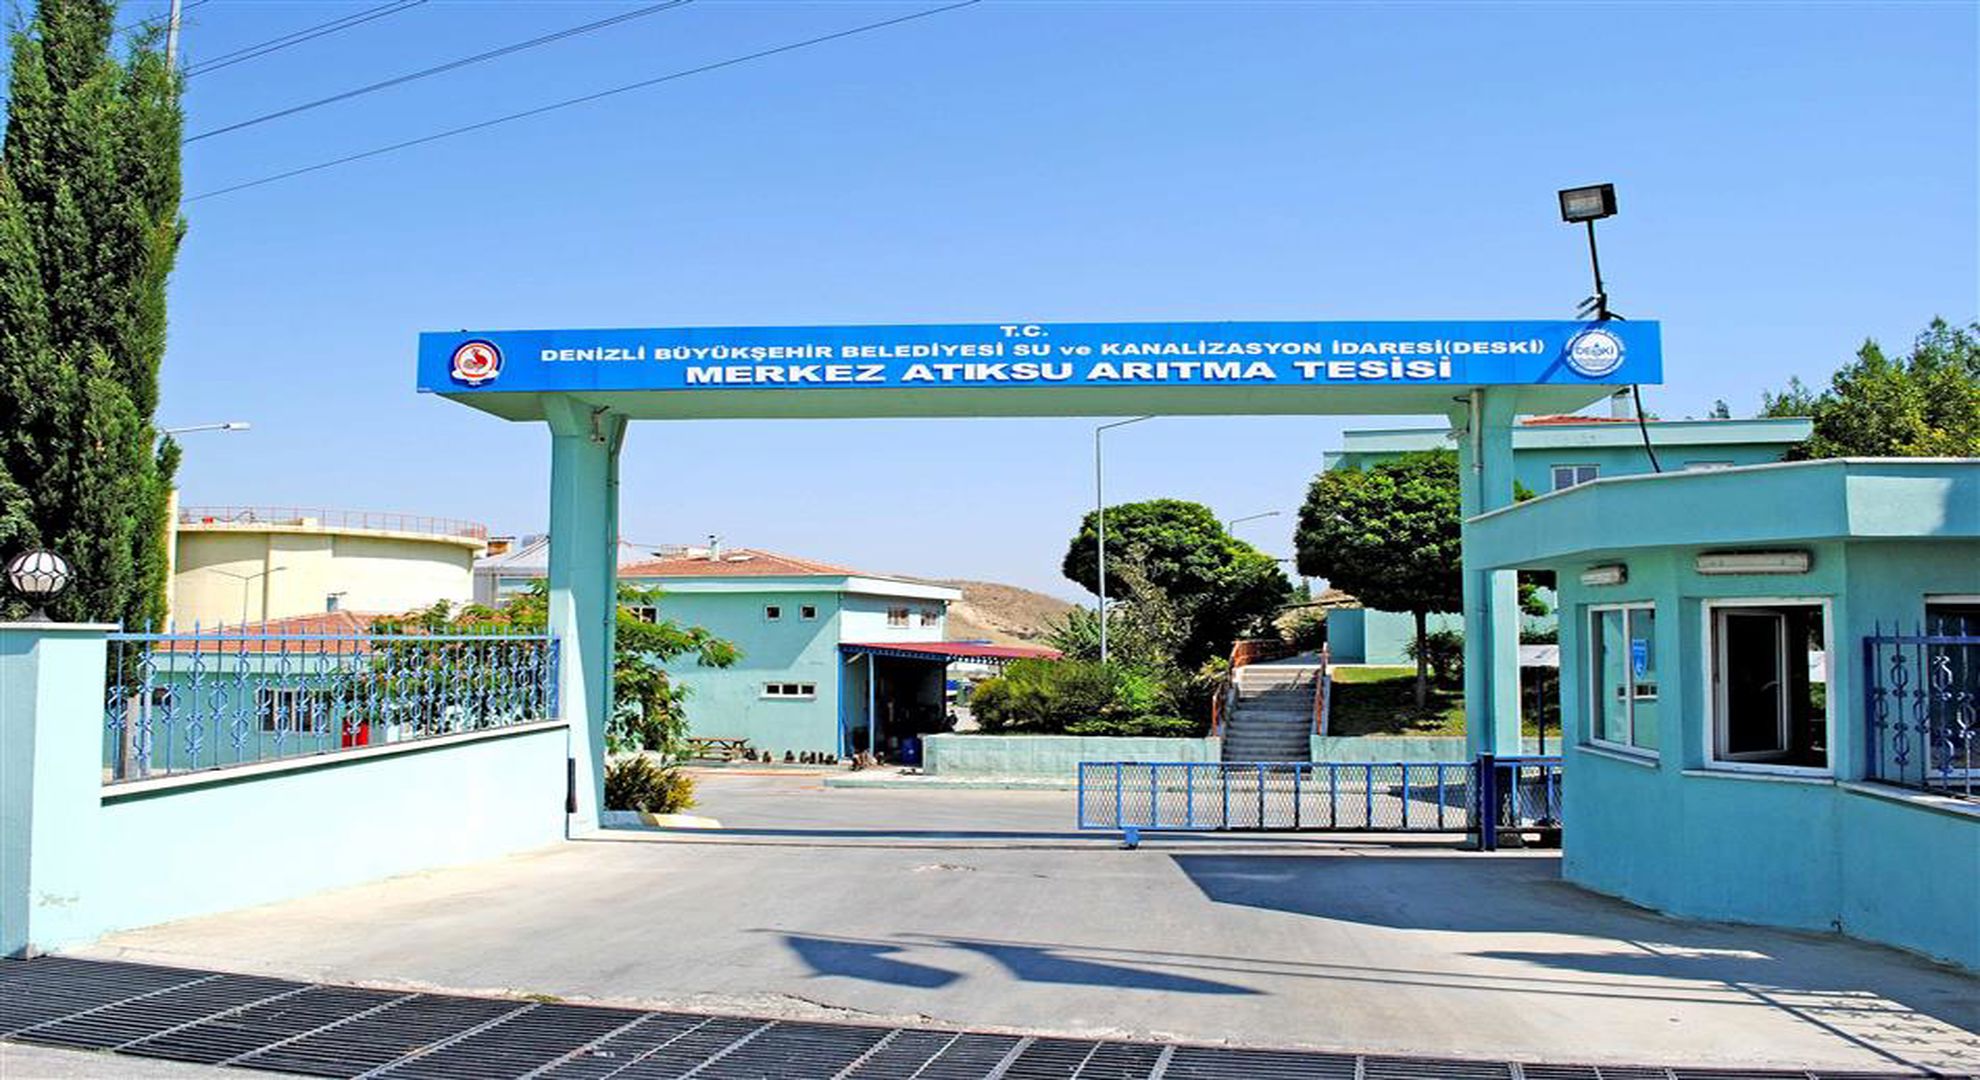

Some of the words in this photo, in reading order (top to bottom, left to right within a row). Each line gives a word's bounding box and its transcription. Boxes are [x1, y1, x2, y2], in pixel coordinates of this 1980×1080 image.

[1000, 325, 1048, 337] T.C.
[541, 346, 645, 361] DENİZLİ
[654, 345, 833, 361] BÜYÜKŞEHİR
[841, 342, 1004, 358] BELEDİYESİ
[1013, 343, 1051, 356] SU
[1060, 346, 1091, 355] ve
[1101, 341, 1322, 356] KANALİZASYON
[686, 364, 886, 383] MERKEZ
[901, 362, 1073, 381] ATIKSU
[1087, 361, 1277, 380] ARITMA
[1293, 356, 1452, 378] TESİSİ
